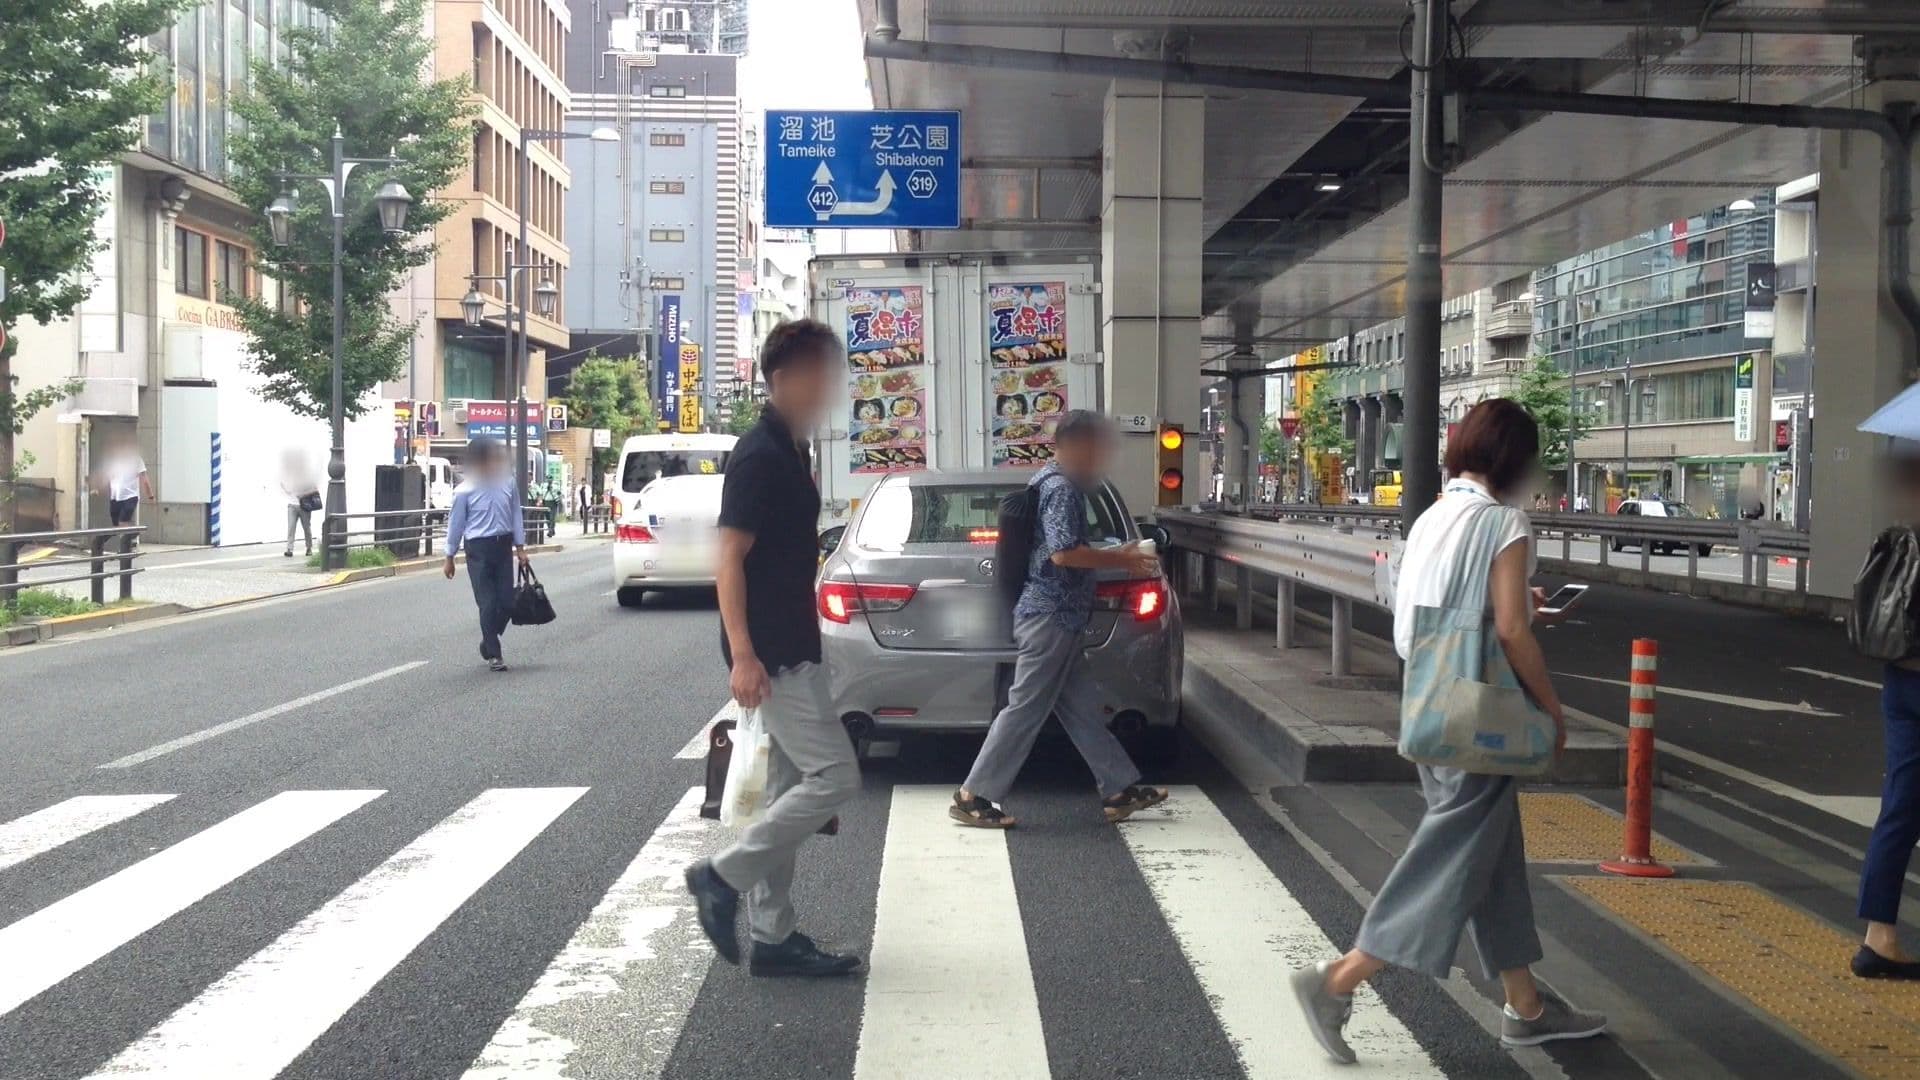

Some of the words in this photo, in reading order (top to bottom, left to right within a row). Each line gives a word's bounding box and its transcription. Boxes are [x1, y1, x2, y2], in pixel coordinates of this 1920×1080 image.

[779, 116, 835, 141] 溜池
[870, 124, 949, 150] 芝公園
[778, 143, 836, 157] Tameike
[875, 152, 944, 167] Shibakoen
[911, 176, 933, 192] 319
[812, 191, 834, 206] 412
[668, 304, 678, 343] MIZUHO
[682, 367, 697, 428] 中華そば
